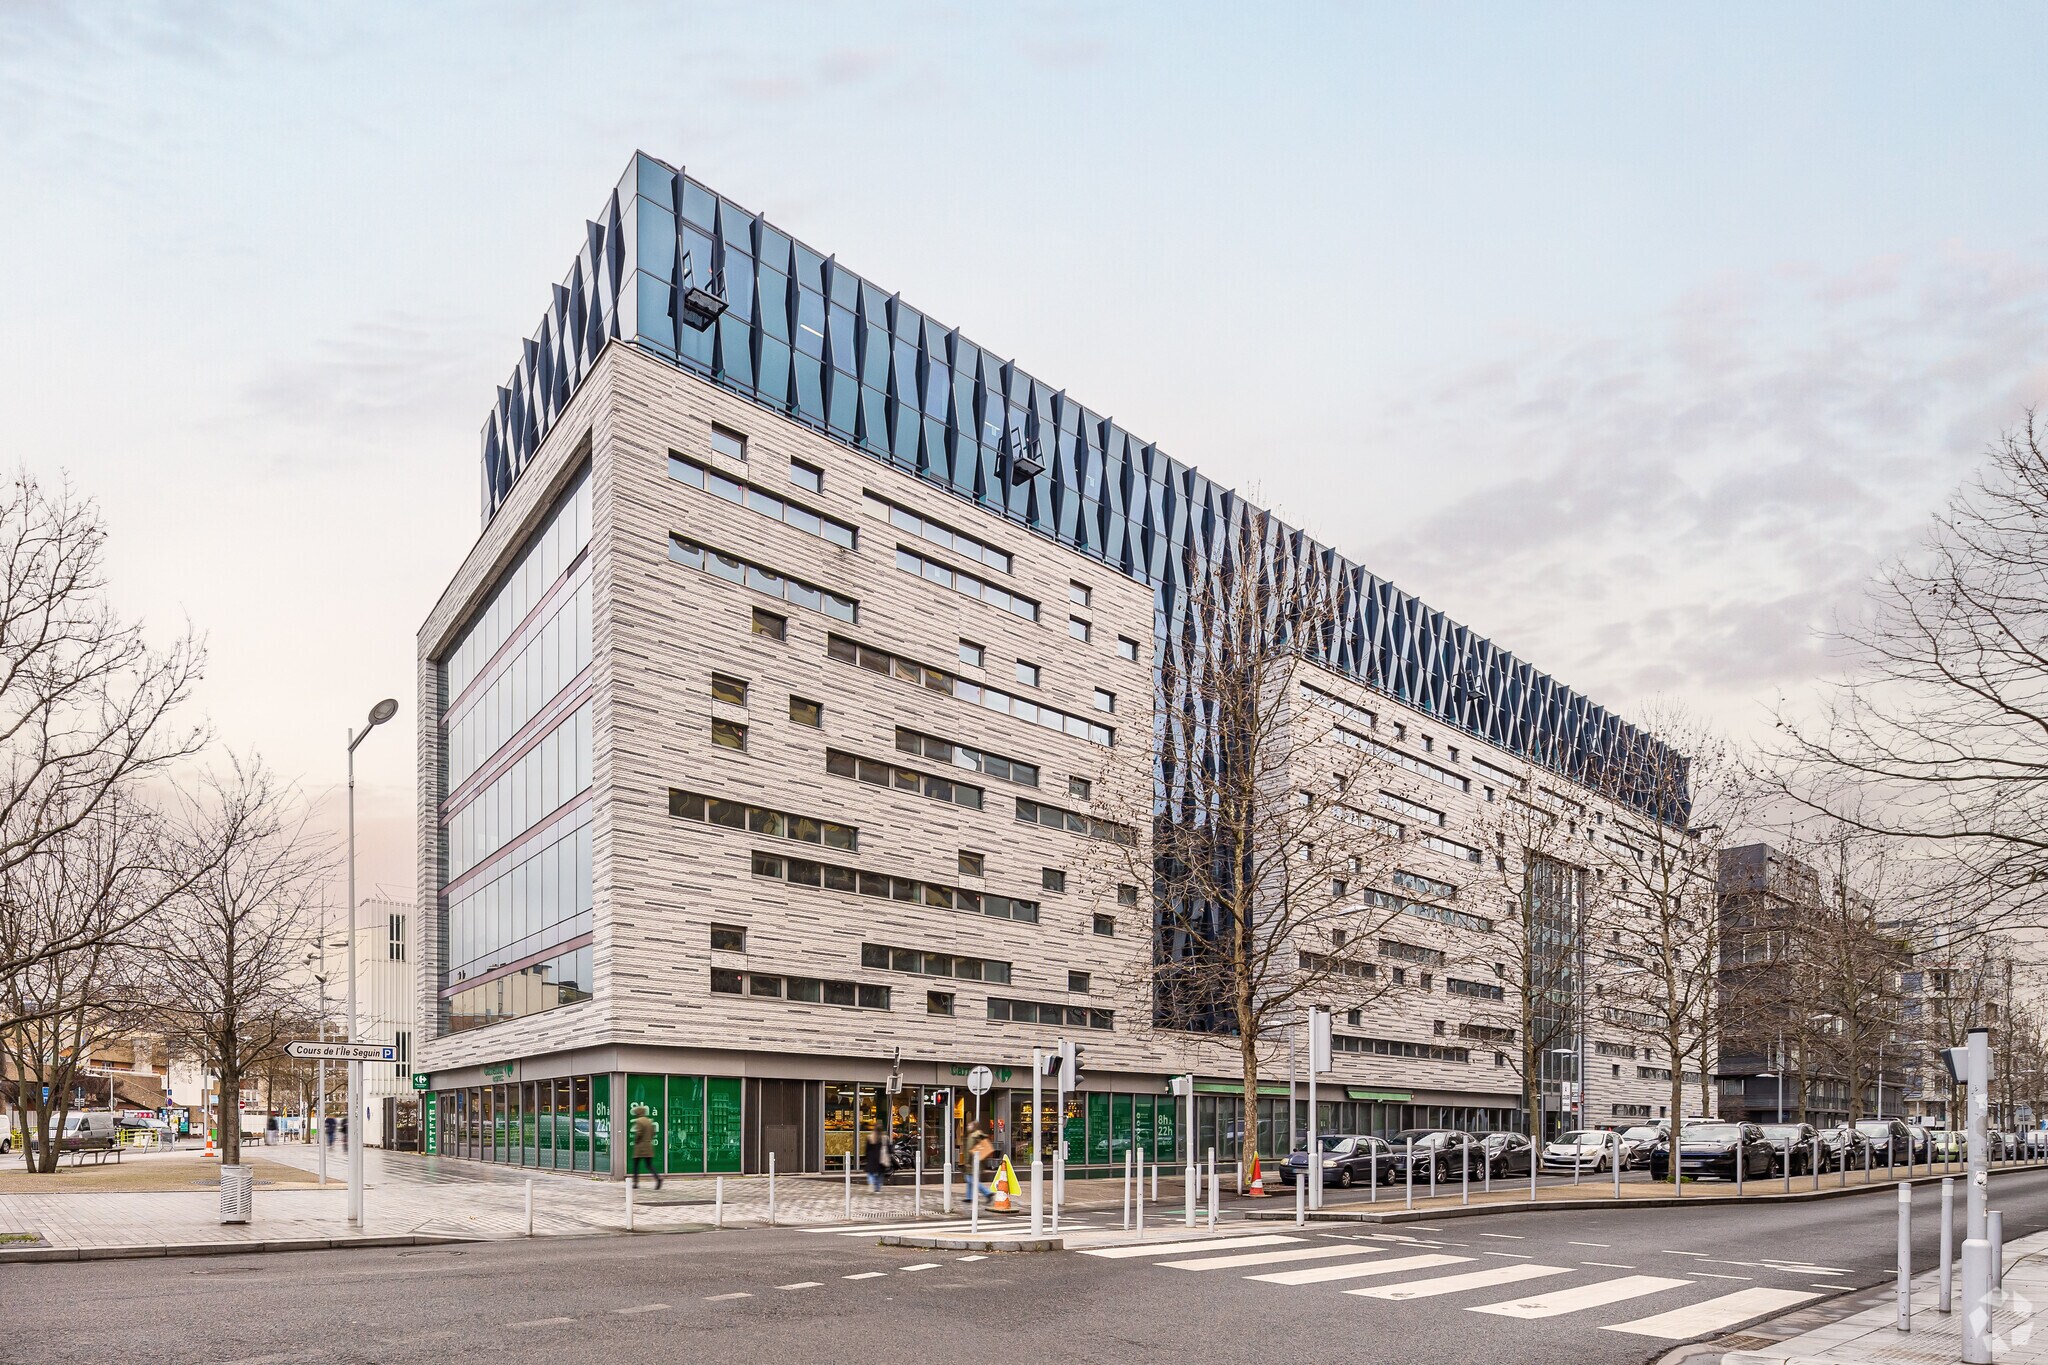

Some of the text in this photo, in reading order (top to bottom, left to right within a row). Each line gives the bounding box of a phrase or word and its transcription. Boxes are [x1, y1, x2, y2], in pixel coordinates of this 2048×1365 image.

[297, 1045, 391, 1059] Cours de l'Île Seguin P
[596, 1102, 606, 1116] 8h
[652, 1107, 658, 1116] à
[596, 1118, 611, 1132] 22h
[1158, 1114, 1168, 1124] 8h
[1158, 1126, 1172, 1136] 22h
